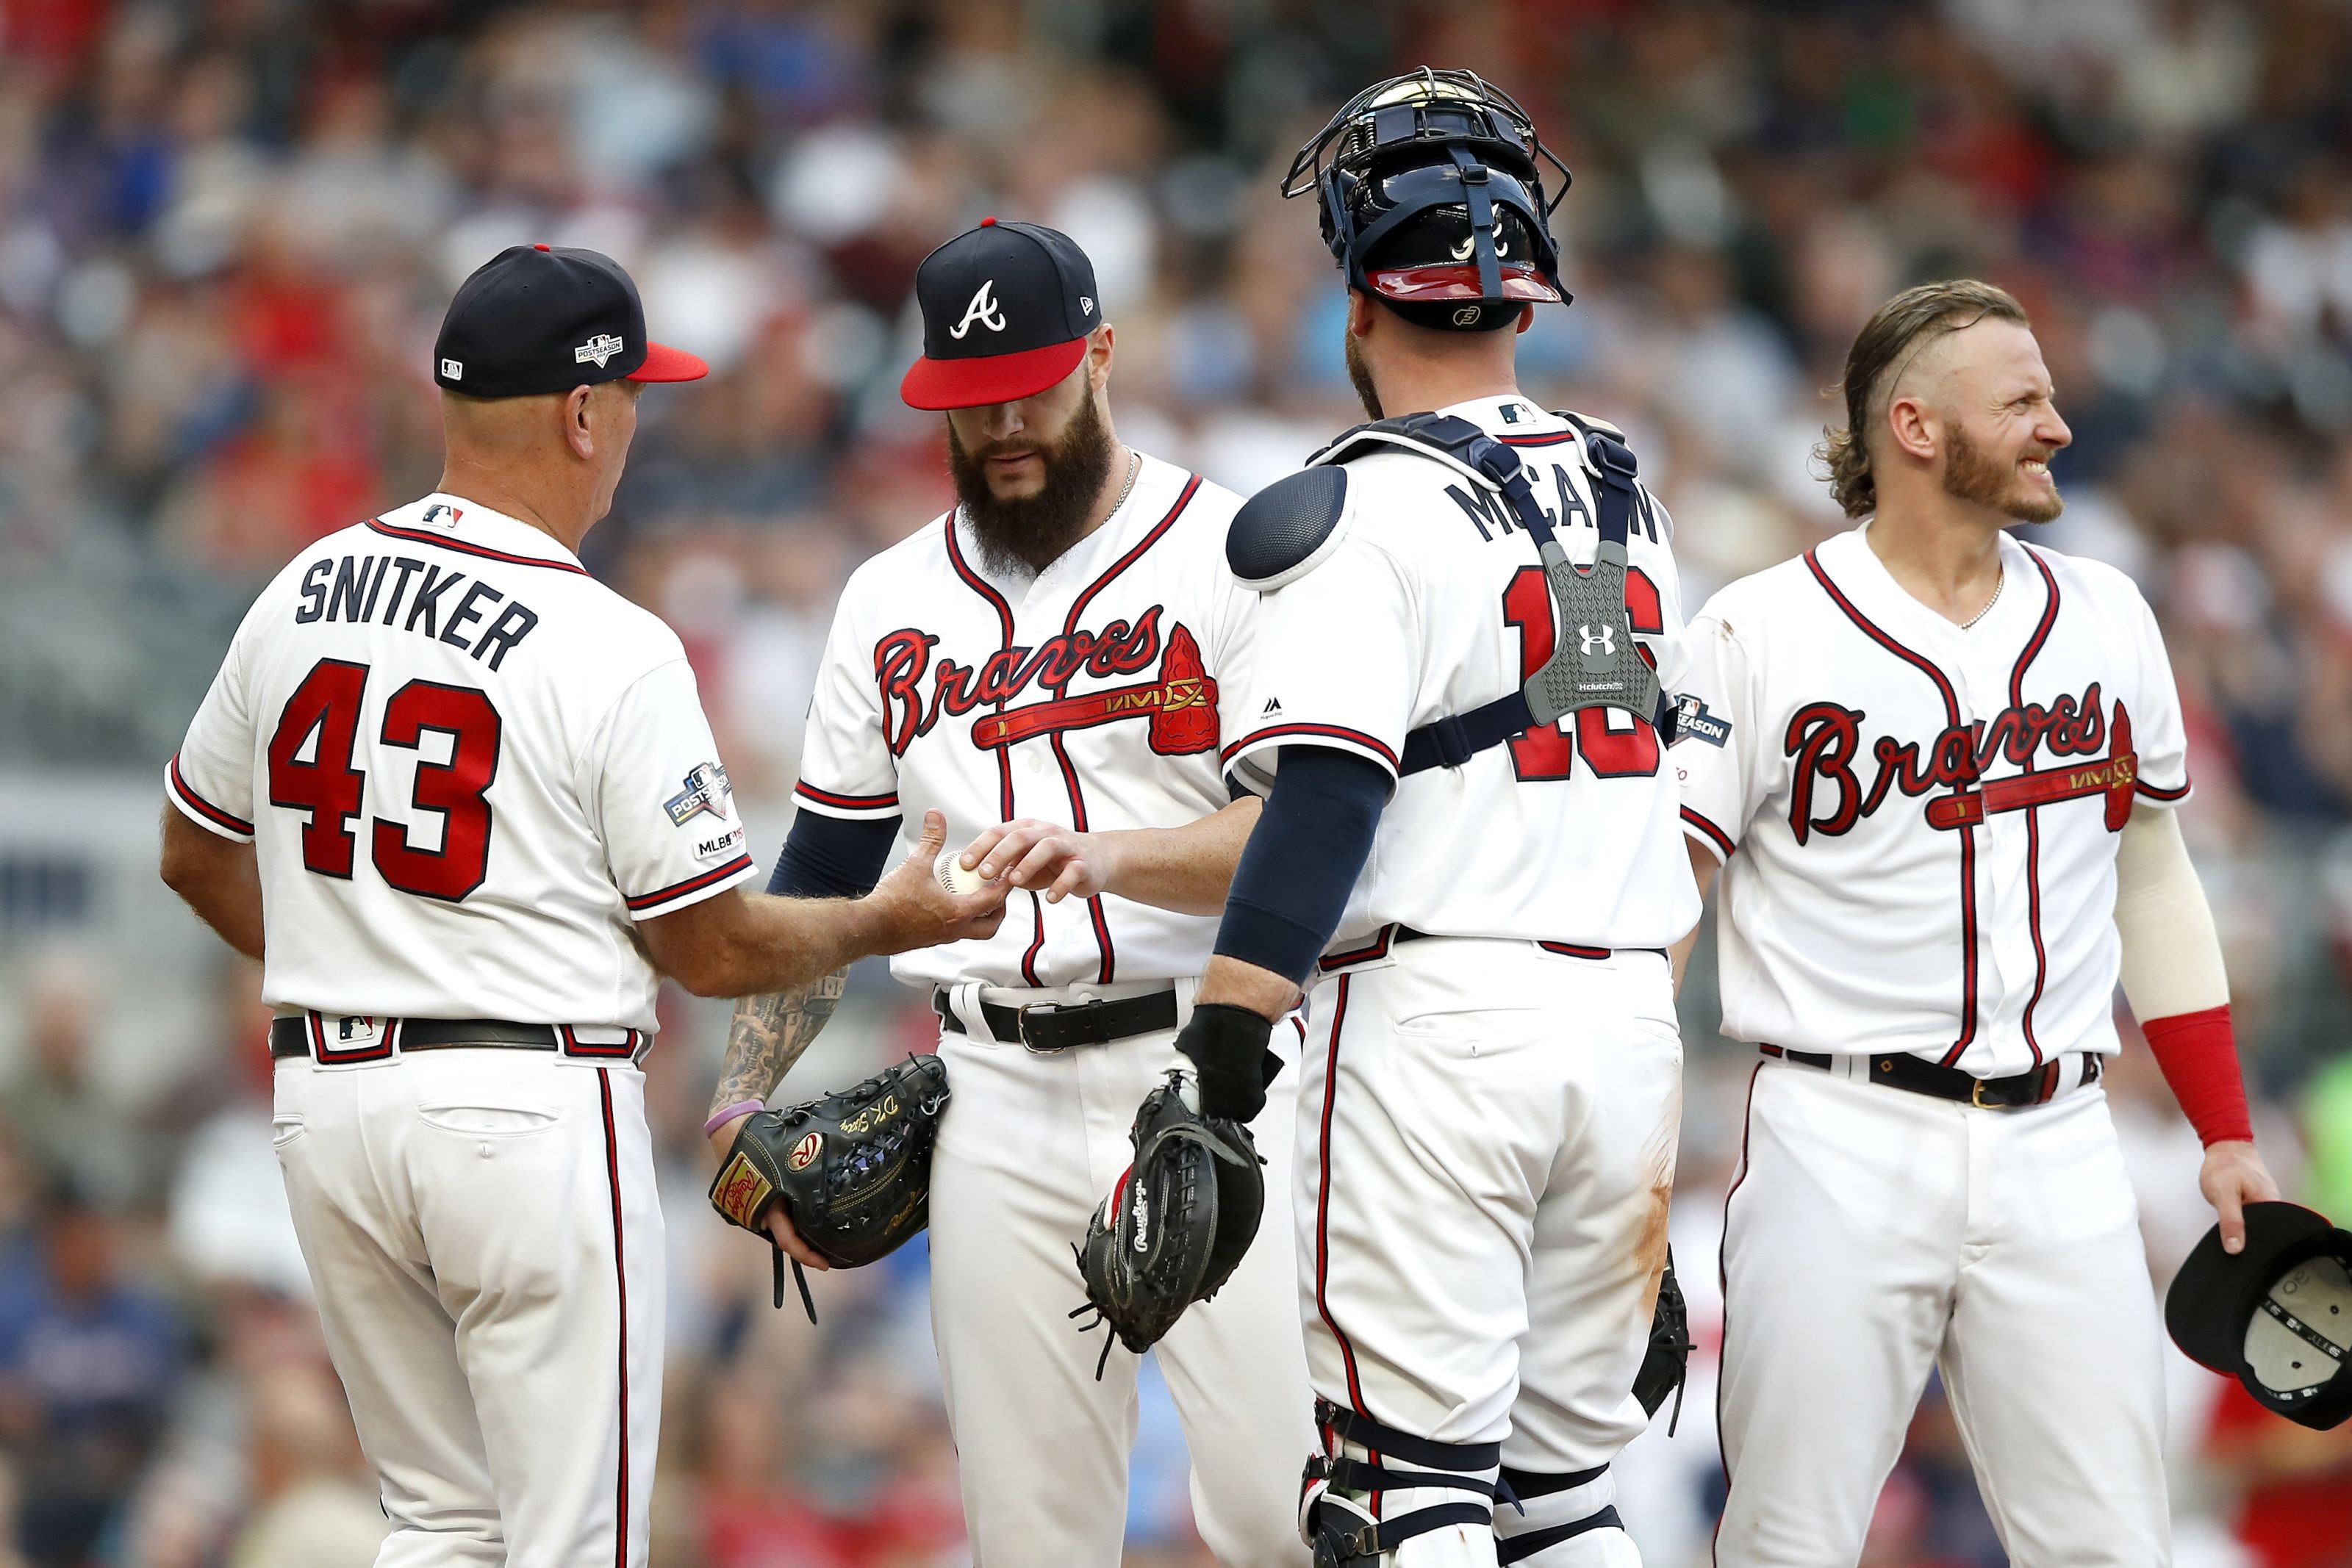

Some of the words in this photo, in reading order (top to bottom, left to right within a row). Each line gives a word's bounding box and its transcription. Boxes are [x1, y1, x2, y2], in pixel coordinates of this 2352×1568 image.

[578, 341, 621, 359] POSTSEASON
[950, 279, 1007, 340] A
[295, 555, 538, 672] SNITKER
[874, 604, 1164, 758] Braves
[1502, 564, 1664, 783] 16
[267, 657, 502, 904] 43
[671, 772, 729, 817] POSTSEASON
[1785, 681, 2106, 846] Braves
[698, 836, 726, 855] MLB
[1131, 1178, 1149, 1253] Rawlings
